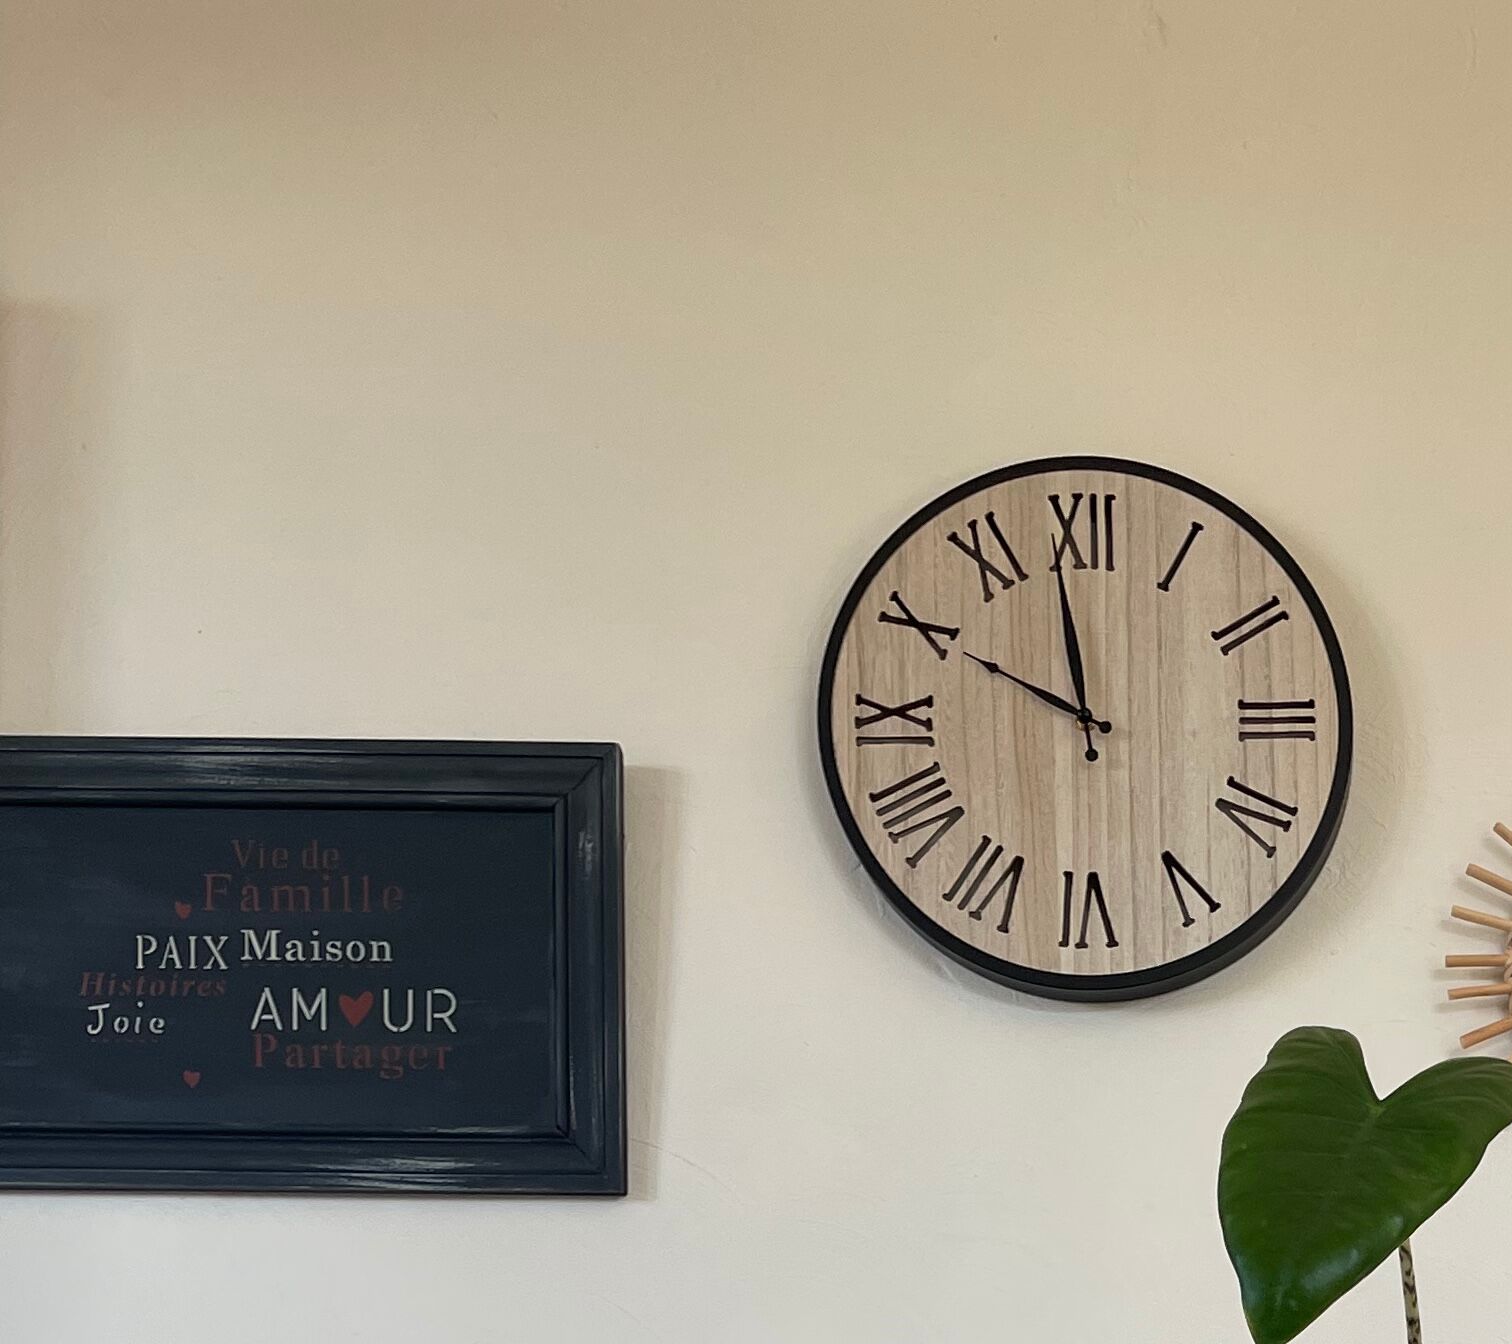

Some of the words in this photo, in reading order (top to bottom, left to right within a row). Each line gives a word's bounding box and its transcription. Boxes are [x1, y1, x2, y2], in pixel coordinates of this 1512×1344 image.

[946, 510, 1029, 603] XI
[1047, 492, 1116, 573] XII
[877, 590, 960, 660] X
[854, 693, 934, 747] IX
[1237, 698, 1316, 742] III
[868, 761, 966, 868] VIII
[1214, 775, 1299, 859] IV
[231, 839, 289, 870] Vie
[301, 839, 341, 870] de
[203, 873, 404, 914] Famille
[941, 834, 1025, 933] VII
[1057, 870, 1120, 949] VI
[1160, 850, 1222, 928] V
[135, 934, 230, 971] PAIX
[239, 928, 393, 963] Maison
[78, 971, 226, 998] Histoires
[86, 1001, 167, 1036] Joie
[251, 1033, 453, 1080] Partager
